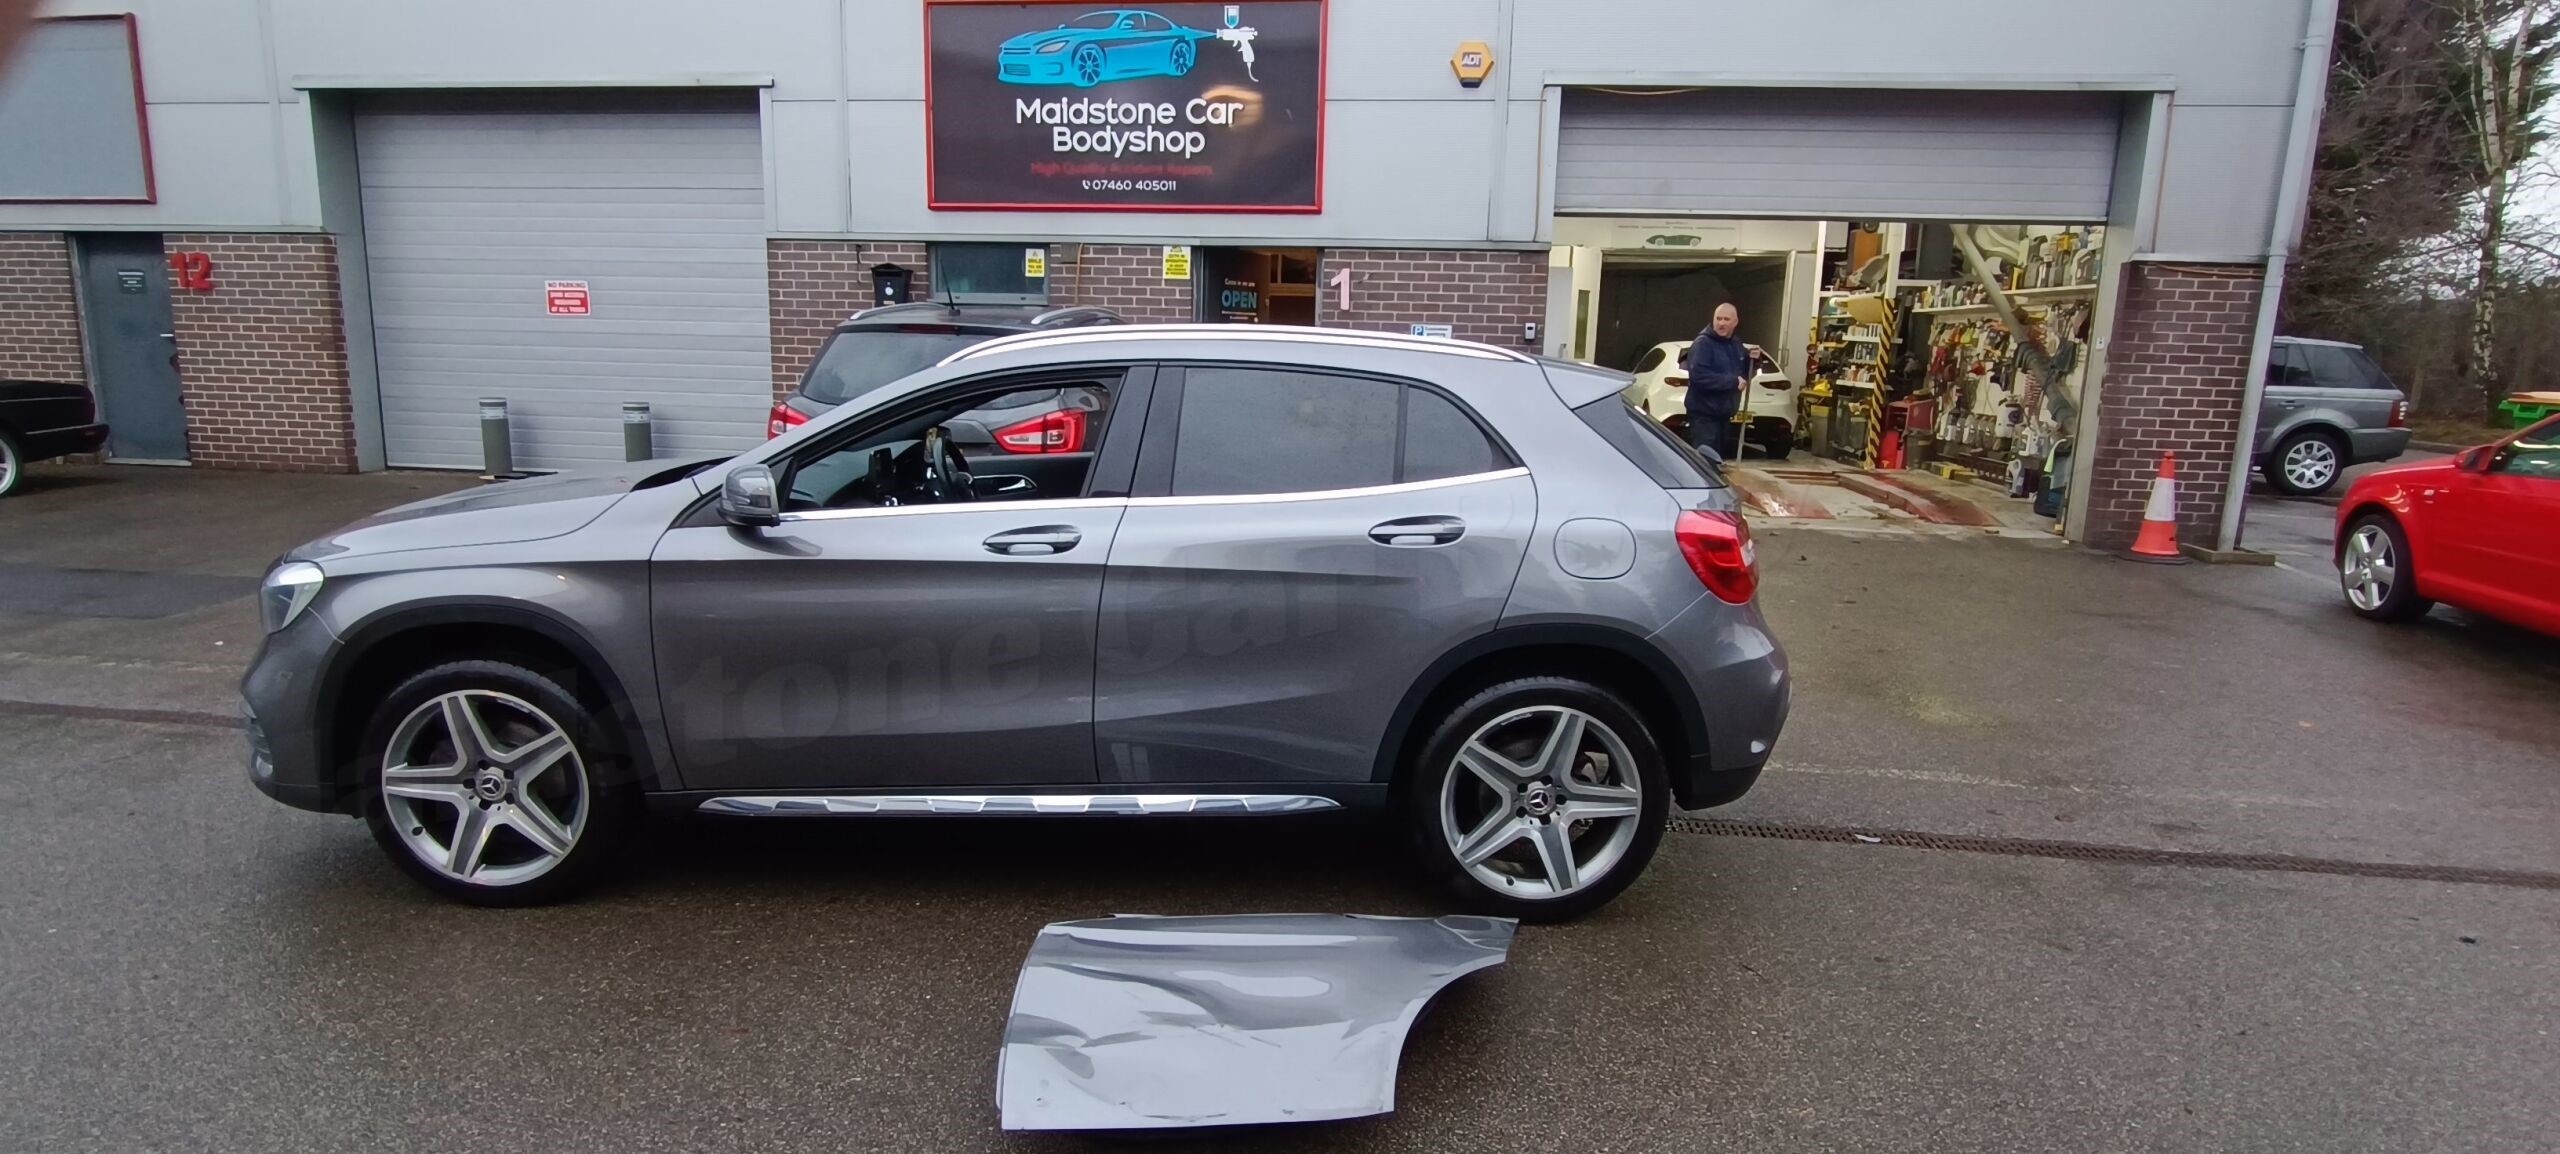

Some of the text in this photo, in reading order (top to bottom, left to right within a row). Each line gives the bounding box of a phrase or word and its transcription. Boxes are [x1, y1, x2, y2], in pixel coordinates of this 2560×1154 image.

[1462, 53, 1480, 65] ADT
[1016, 97, 1244, 125] Maidstone Car
[1053, 125, 1206, 159] Bodyshop
[1092, 180, 1177, 192] 07460 405011
[170, 251, 214, 291] 12
[1222, 290, 1257, 308] OPEN
[1331, 268, 1350, 310] 1
